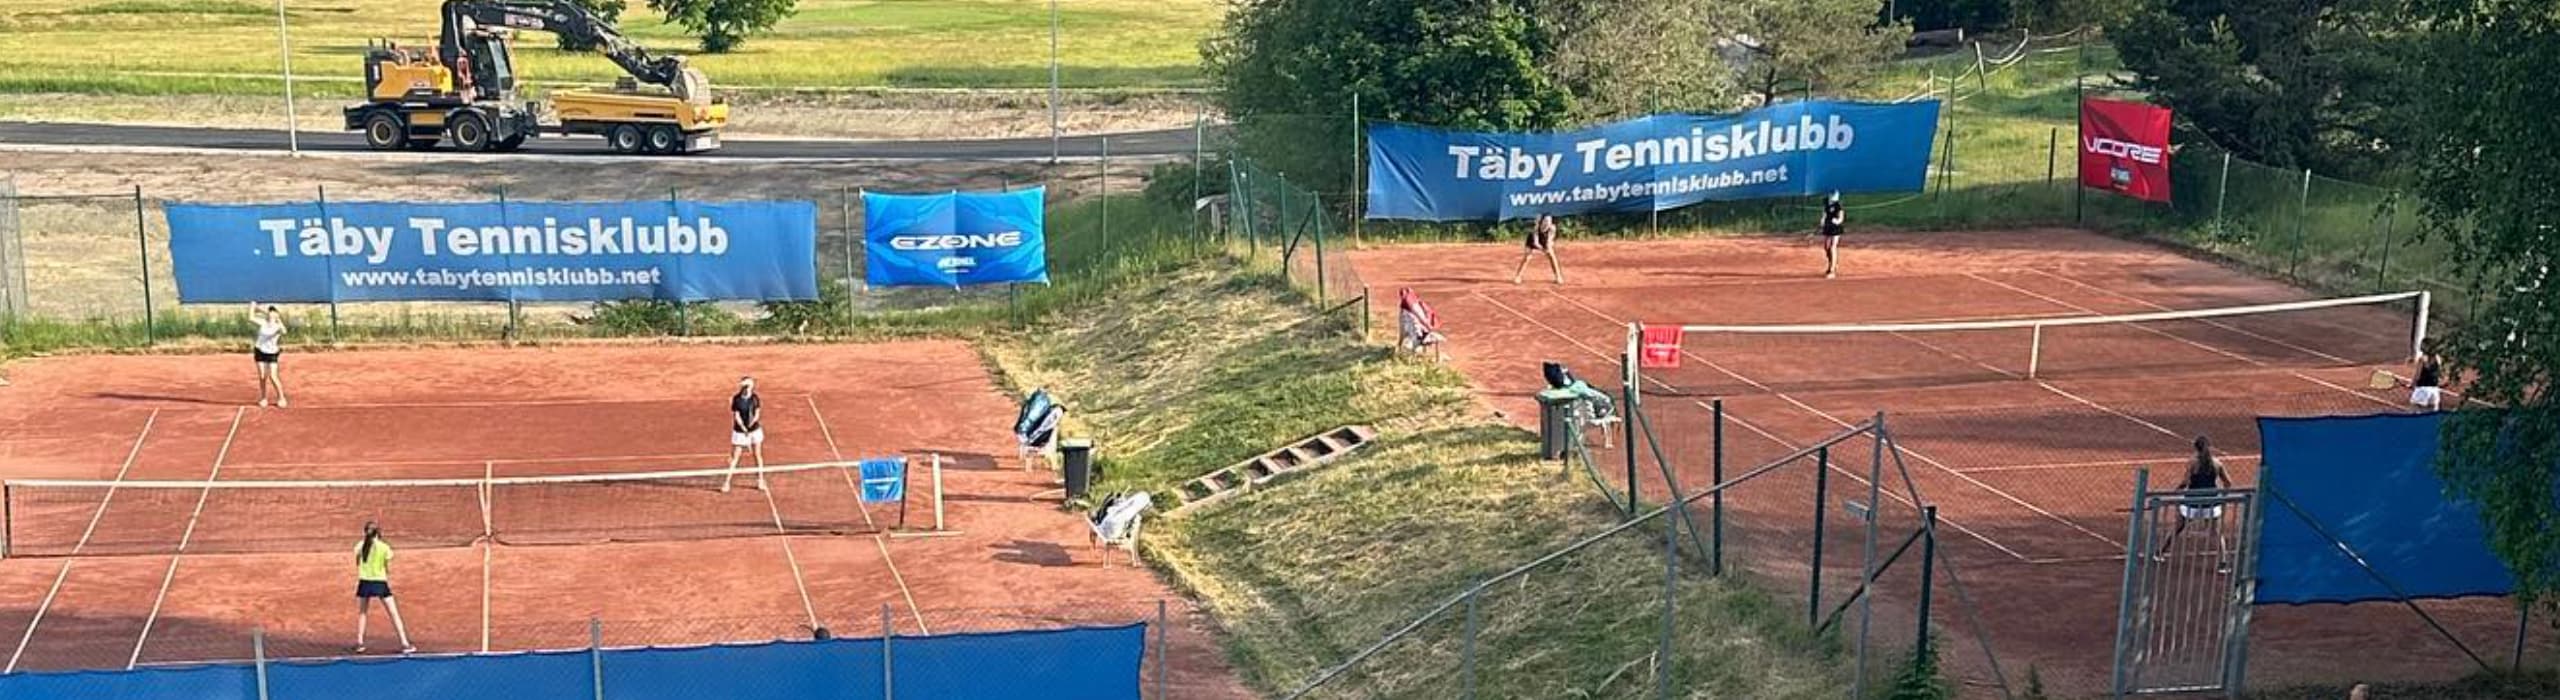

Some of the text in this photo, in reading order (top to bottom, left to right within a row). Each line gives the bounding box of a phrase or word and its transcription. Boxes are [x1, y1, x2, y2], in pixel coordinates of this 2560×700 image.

[1449, 116, 1853, 186] Täby Tennisklubb
[2083, 136, 2162, 164] VCORE
[1510, 165, 1788, 207] www.tabytennisklubb.net
[260, 215, 728, 263] Täby Tennisklubb
[890, 231, 1022, 249] EZONE
[342, 268, 661, 287] www.tabytennisklubb.net
